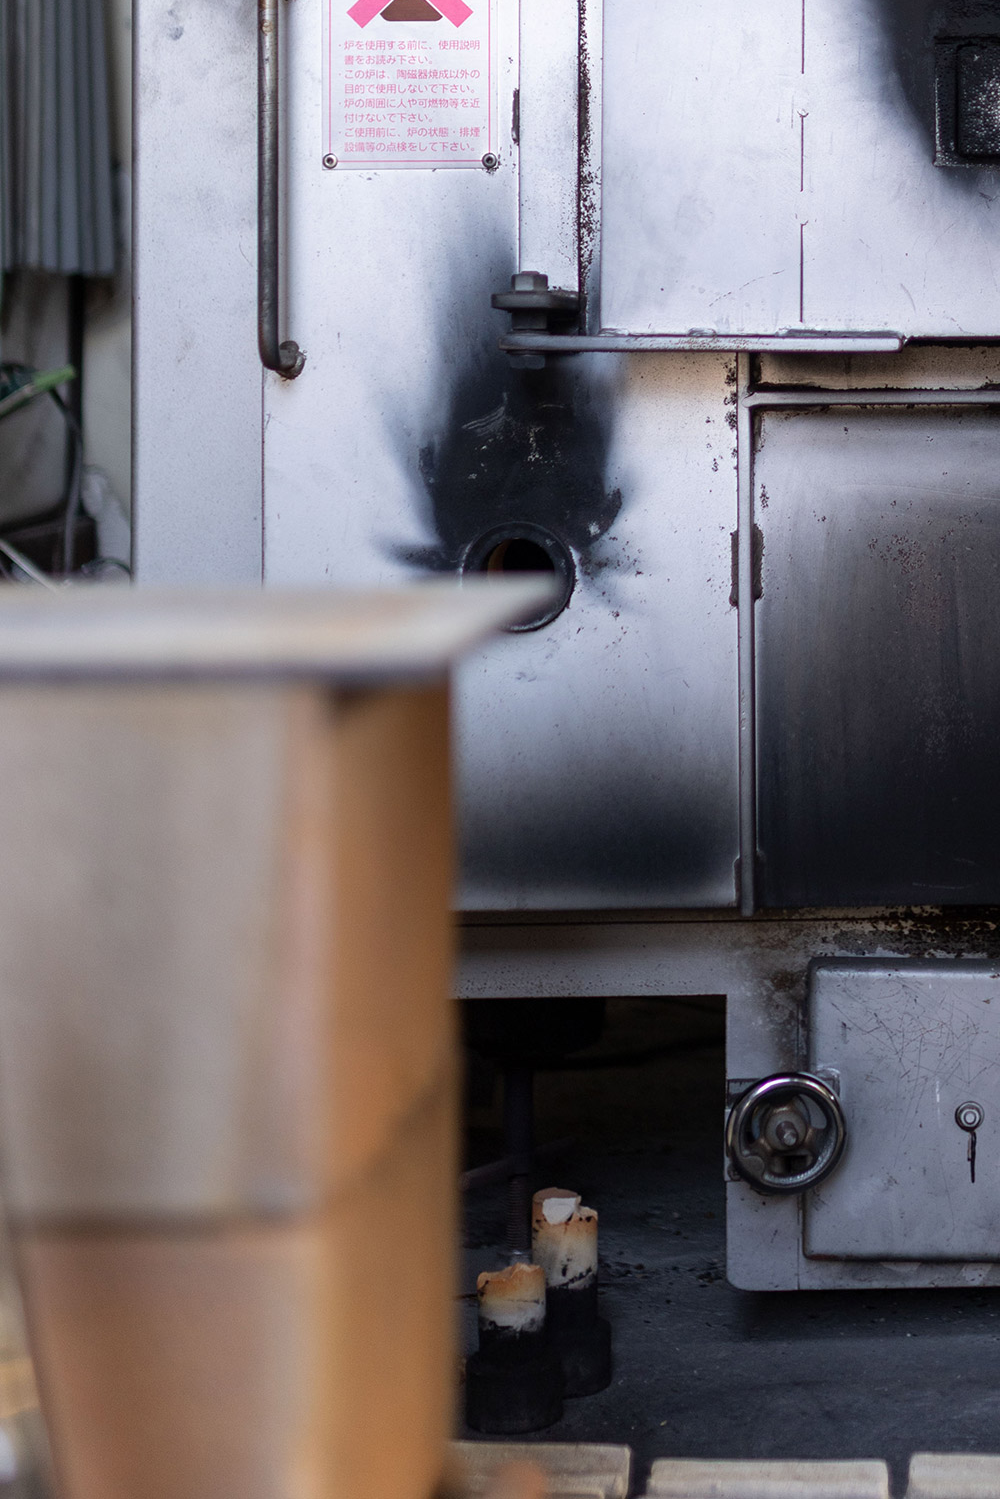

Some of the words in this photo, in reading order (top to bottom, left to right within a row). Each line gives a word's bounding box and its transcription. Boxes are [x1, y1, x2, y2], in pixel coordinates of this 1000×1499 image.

[344, 54, 433, 65] 書をお読み下さい。
[344, 84, 475, 94] 目的で使用しないで下さい。
[344, 113, 433, 123] 付けないで下さい。
